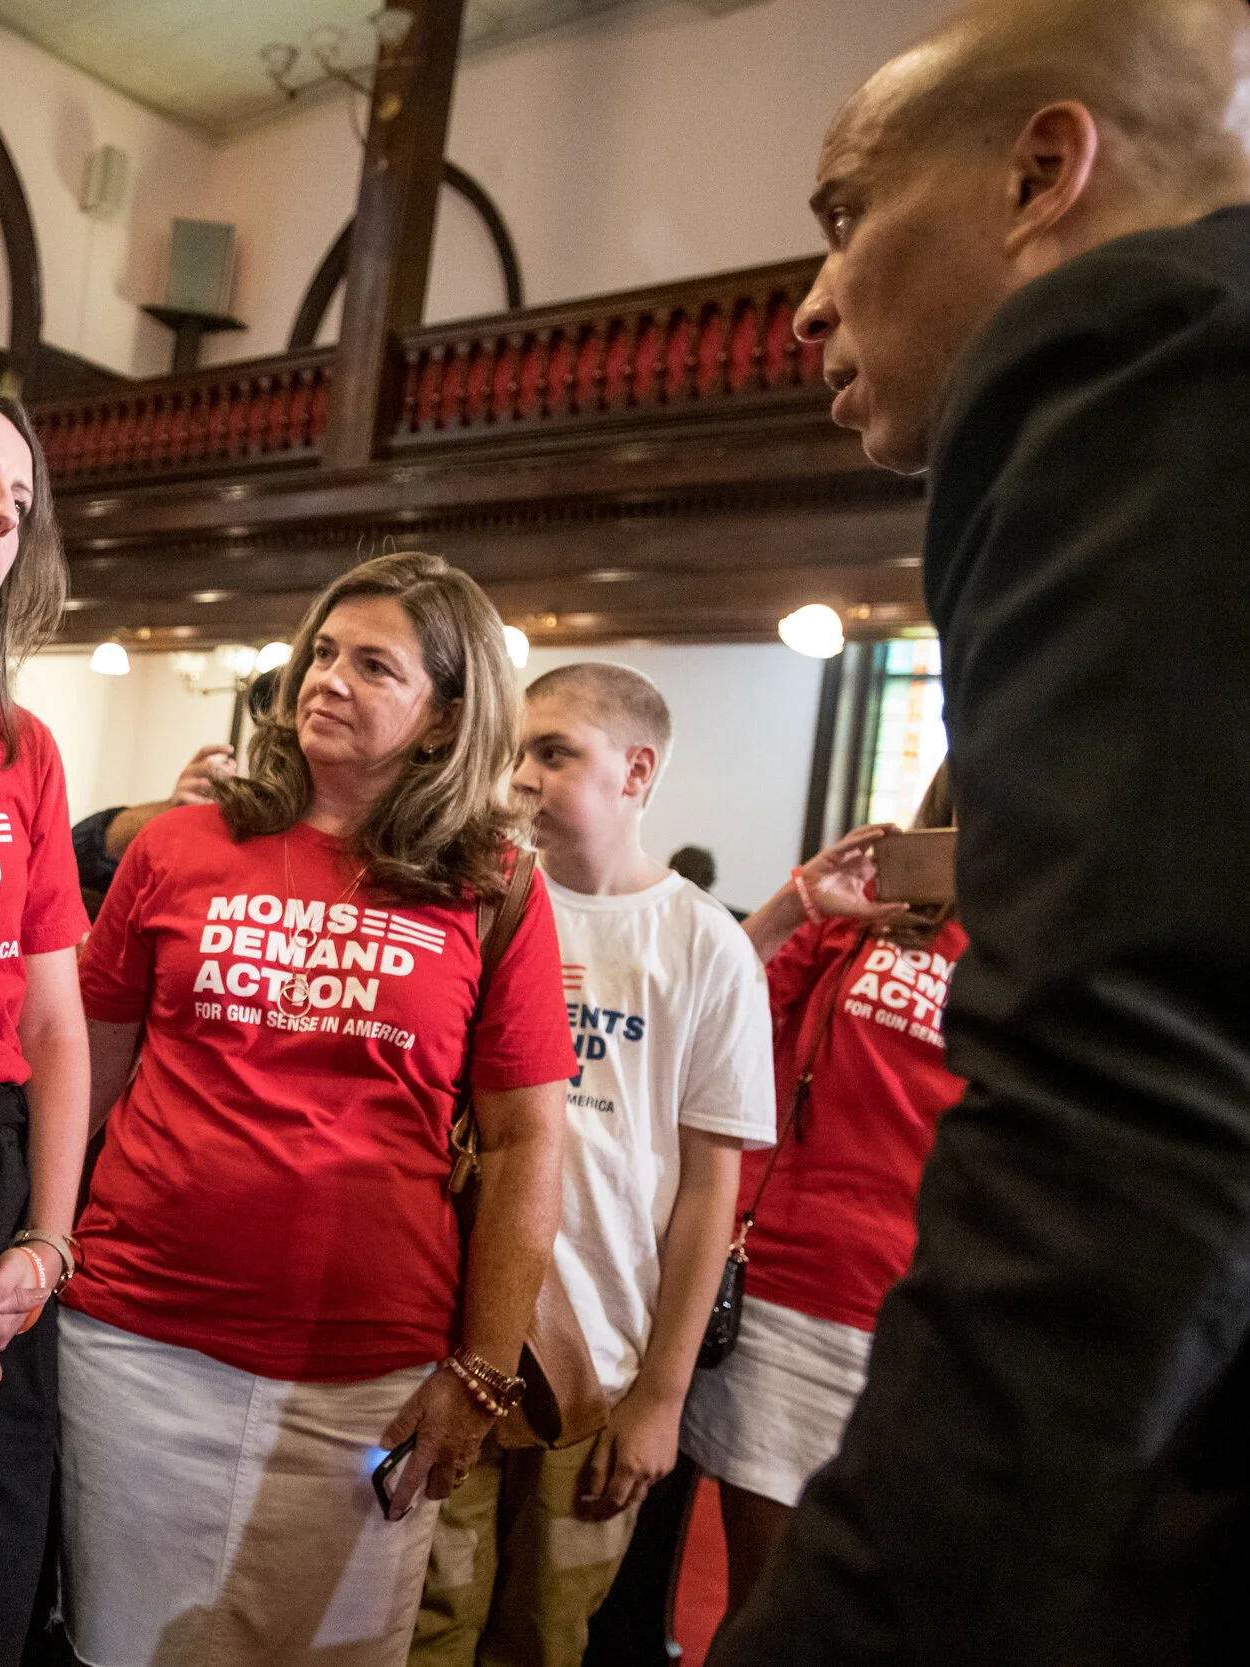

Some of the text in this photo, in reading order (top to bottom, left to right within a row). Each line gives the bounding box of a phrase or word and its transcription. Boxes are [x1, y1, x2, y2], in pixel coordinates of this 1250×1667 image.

[207, 894, 359, 934] MOMS
[200, 925, 415, 976] DEMAND
[880, 942, 958, 984] OM
[193, 960, 379, 1011] ACTION
[851, 972, 942, 1031] ACTI
[864, 949, 948, 1006] DEM
[195, 1002, 415, 1050] FOR GUN SENSE IN AMERICA
[567, 1003, 645, 1041] ENTS
[844, 999, 946, 1049] FOR GUN SENS
[567, 1094, 615, 1113] MERICA
